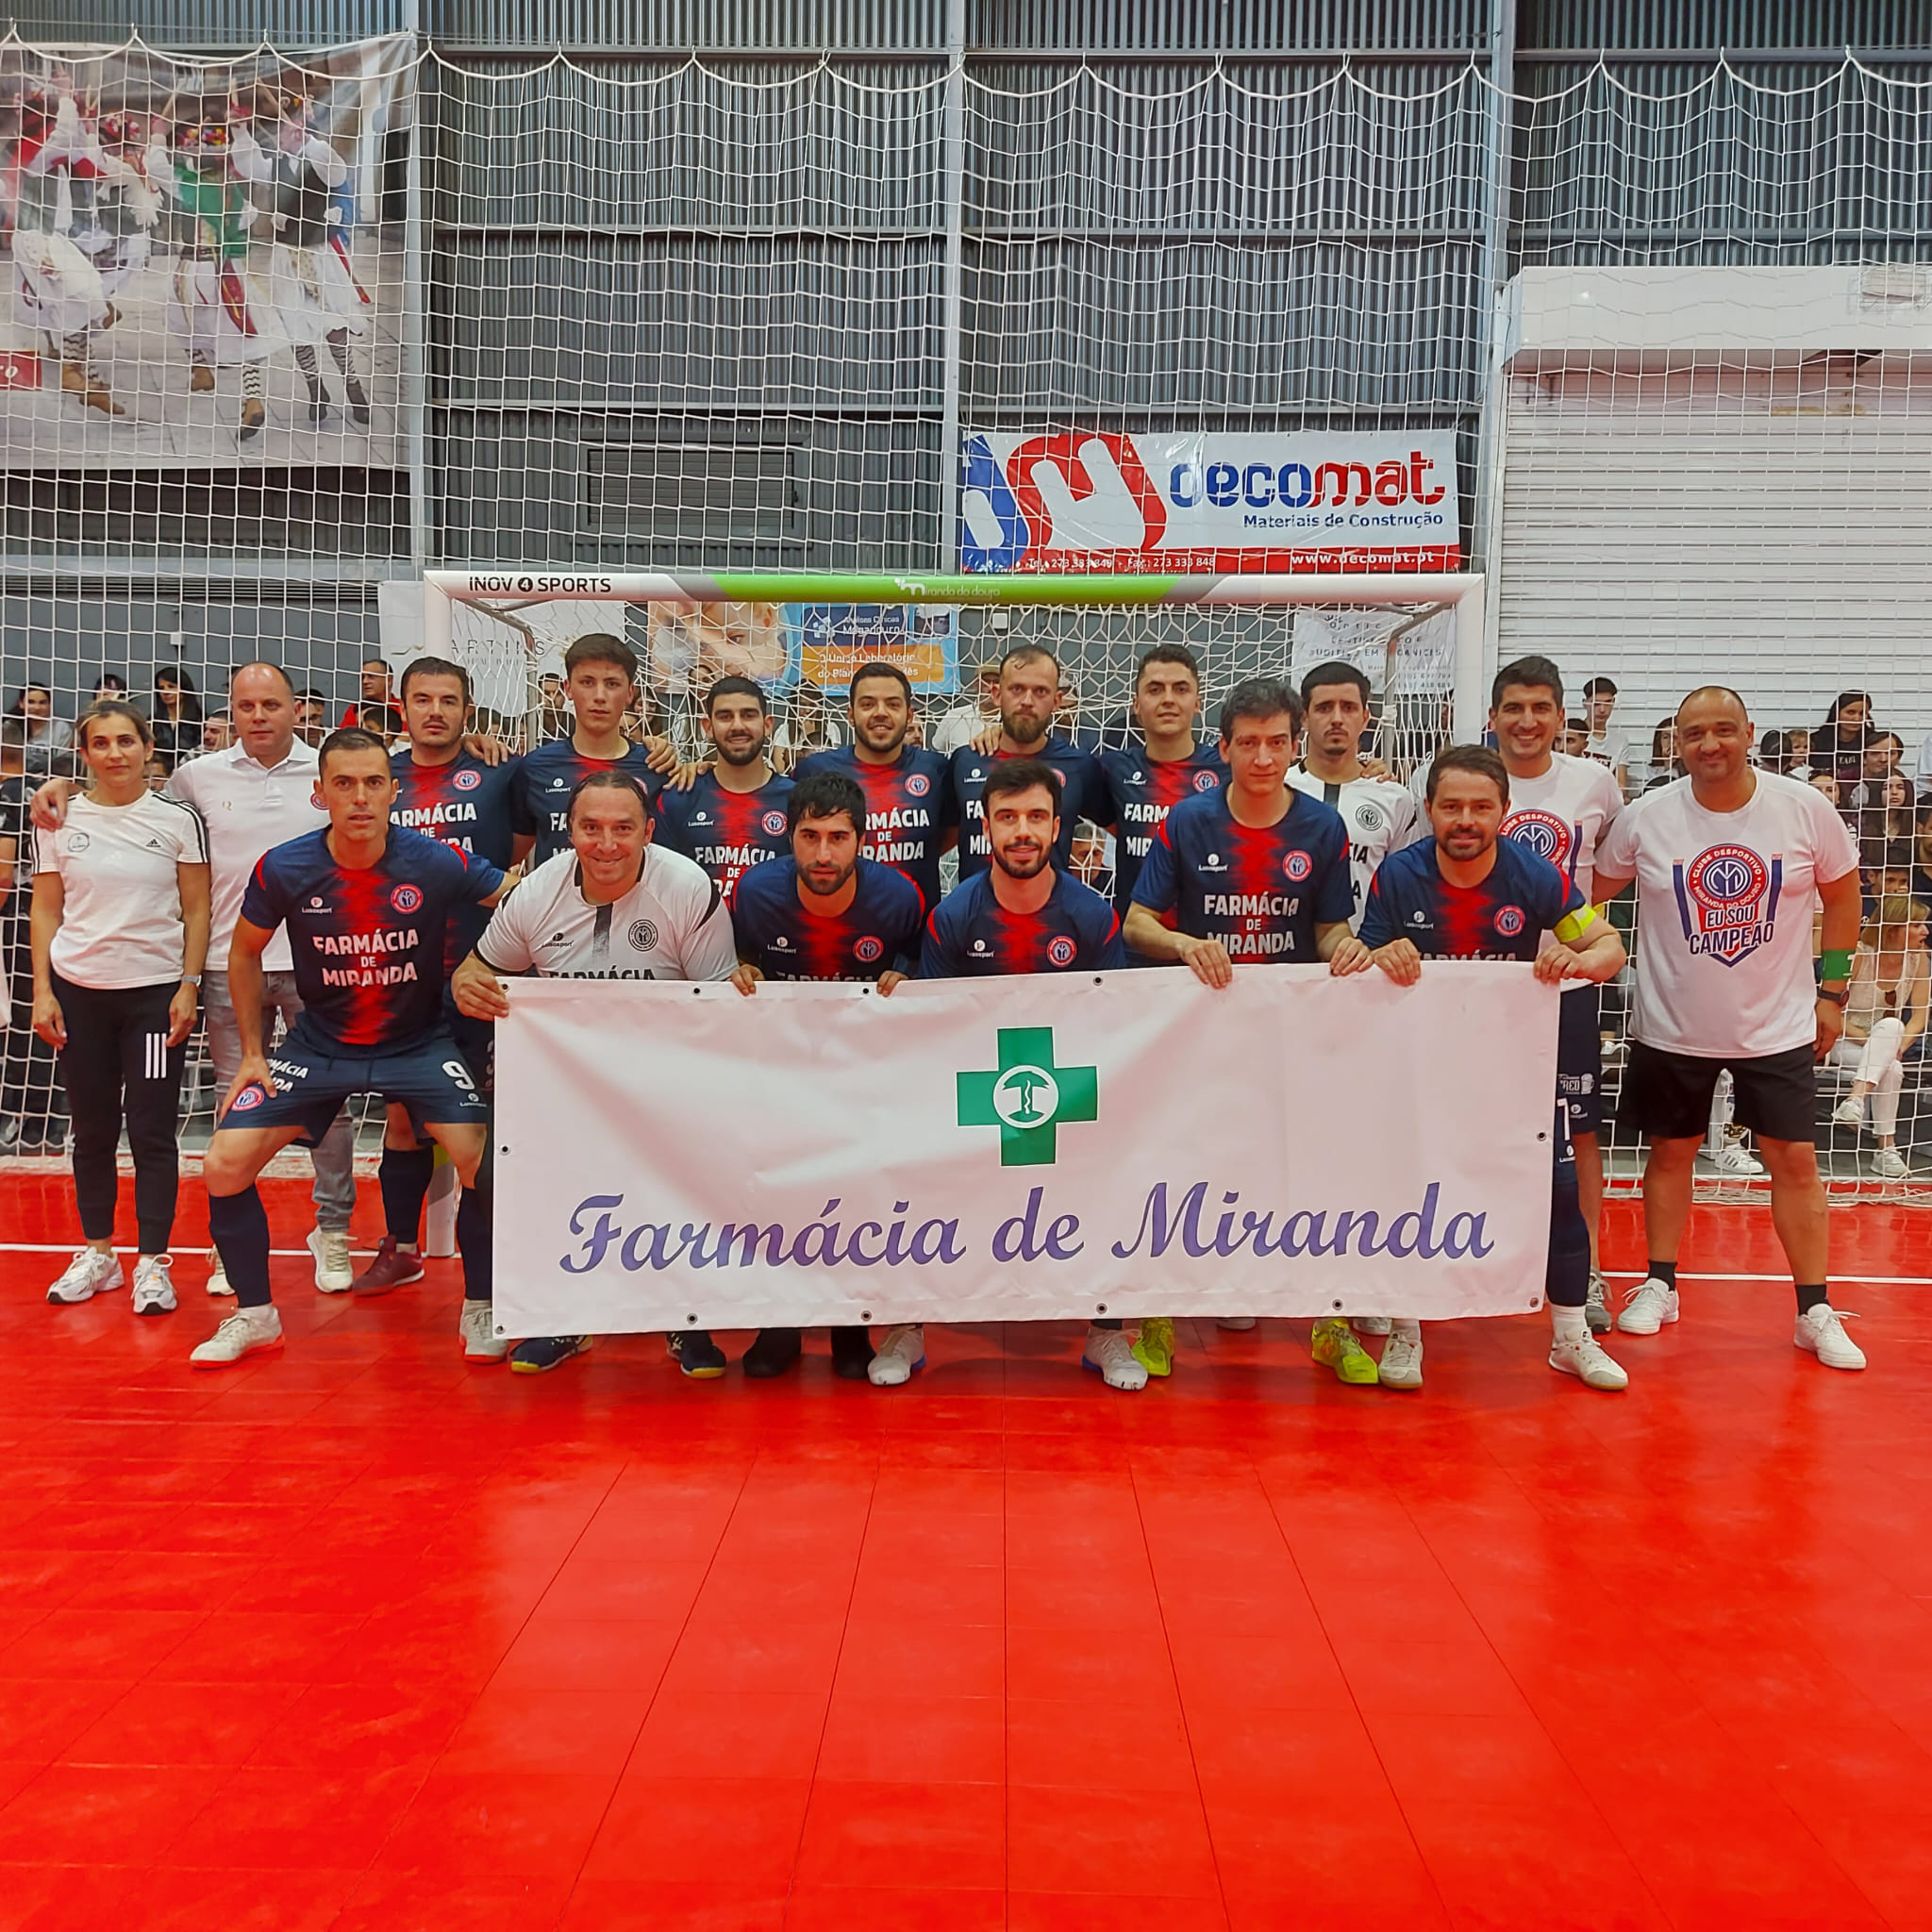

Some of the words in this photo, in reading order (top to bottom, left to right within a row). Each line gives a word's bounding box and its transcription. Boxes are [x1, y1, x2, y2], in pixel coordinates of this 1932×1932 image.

[1243, 514, 1320, 528] Materiais
[1324, 512, 1344, 527] de
[1349, 511, 1443, 528] Construção
[1153, 558, 1172, 567] 273
[1195, 557, 1215, 567] 848
[469, 576, 513, 591] INOV
[538, 577, 611, 593] SPORTS
[390, 802, 477, 827] ARMÁCIA
[866, 808, 930, 830] MÁCIA
[877, 831, 892, 842] DE
[862, 841, 924, 862] RANDA
[1713, 848, 1762, 875] DESPORTIVO
[726, 867, 741, 878] DE
[1204, 891, 1300, 917] FARMÁCIA
[1245, 918, 1262, 931] DE
[1707, 910, 1724, 927] EU
[1726, 906, 1754, 924] SOU
[312, 927, 419, 956] FARMÁCIA
[1689, 920, 1774, 956] CAMPEÃO
[360, 956, 377, 968] DE
[322, 961, 418, 987] MIRANDA
[441, 1060, 475, 1091] 9
[559, 1193, 967, 1274] Farmácia
[991, 1186, 1085, 1262] de
[1111, 1181, 1494, 1258] Miranda
